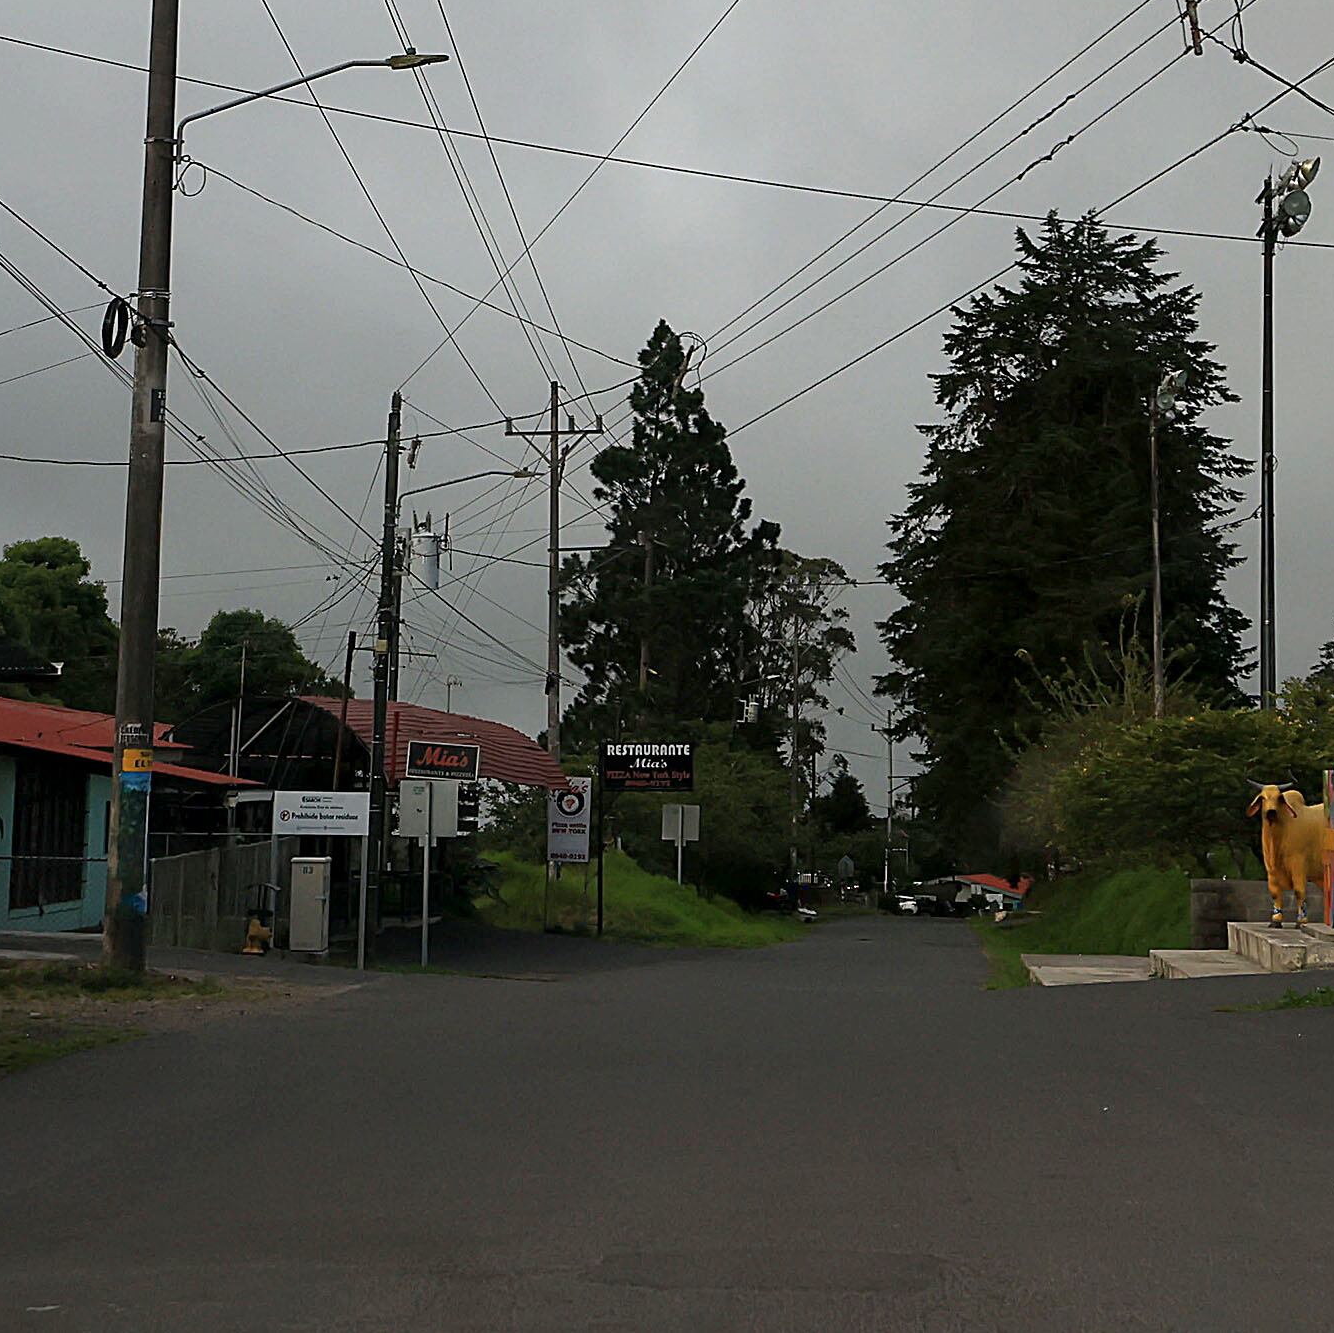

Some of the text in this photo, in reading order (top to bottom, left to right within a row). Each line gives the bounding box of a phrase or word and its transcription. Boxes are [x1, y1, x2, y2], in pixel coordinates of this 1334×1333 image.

[607, 744, 690, 756] RESTAURANTE
[415, 746, 470, 767] Mia's
[630, 757, 667, 768] Mia's
